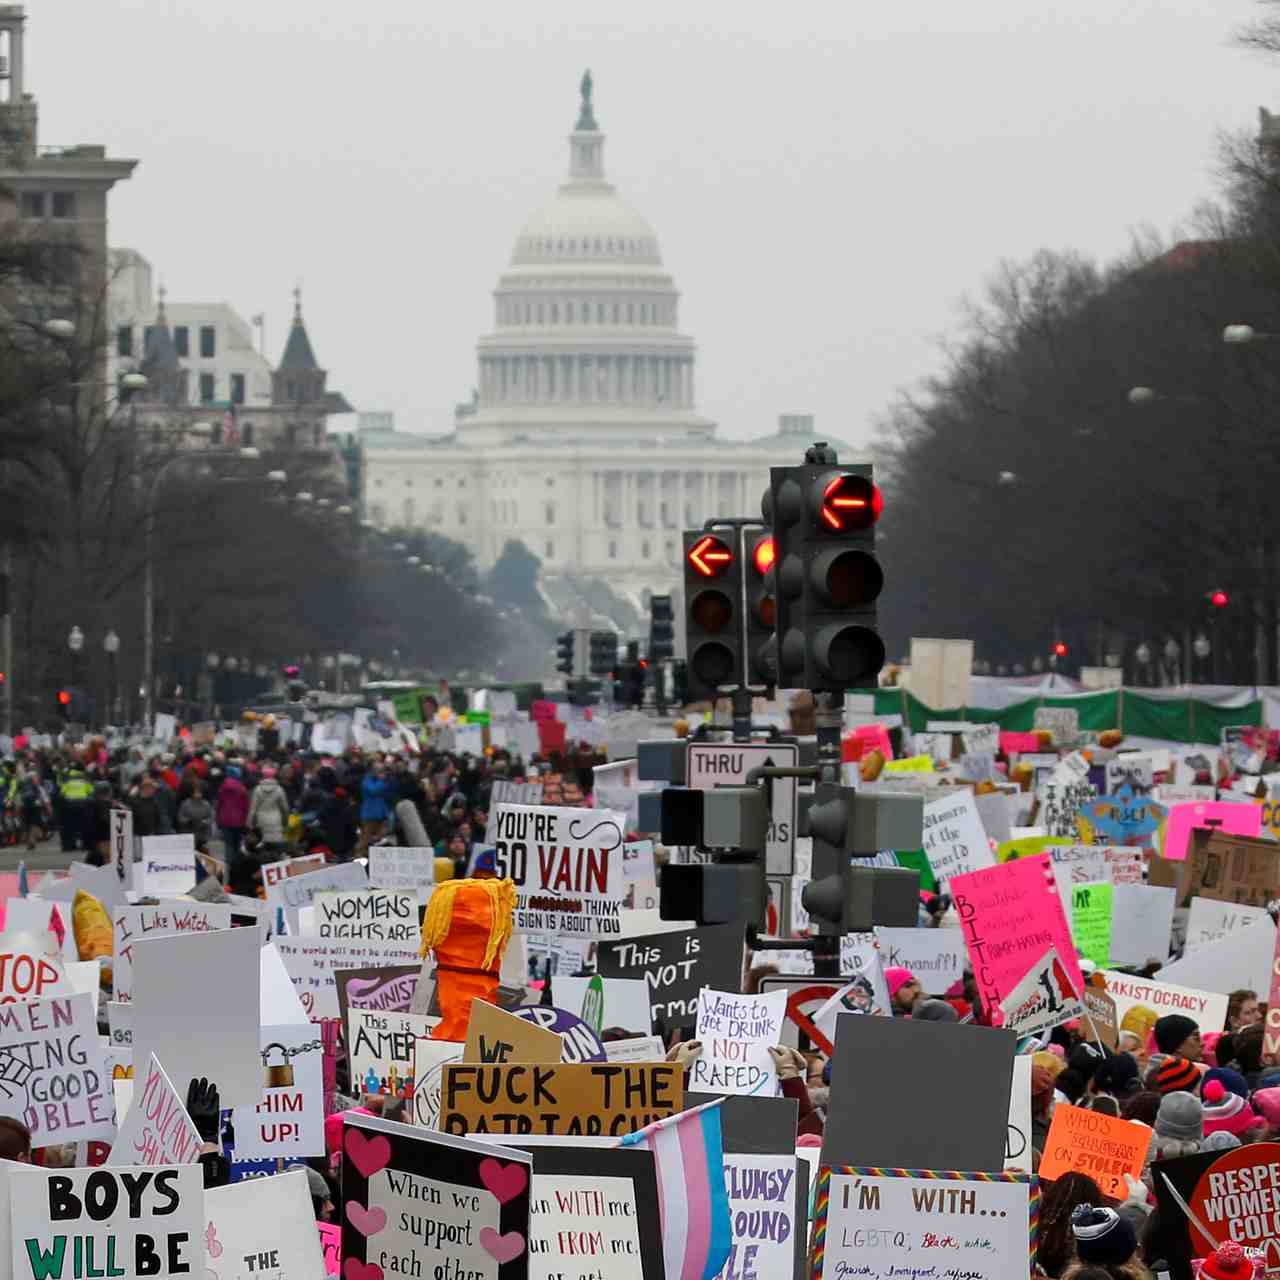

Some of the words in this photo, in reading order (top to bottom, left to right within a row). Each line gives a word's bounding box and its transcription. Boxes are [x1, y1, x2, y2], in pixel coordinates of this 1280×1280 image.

[696, 754, 743, 774] THRU
[496, 812, 557, 841] YOU'RE
[538, 848, 609, 896] VAIN
[322, 895, 411, 920] WOMENS
[585, 900, 620, 915] THINK
[141, 913, 168, 933] Like
[518, 912, 542, 928] SIGN
[546, 914, 556, 930] IS
[560, 915, 593, 932] ABOUT
[597, 917, 620, 934] YOU
[612, 943, 660, 967] This
[685, 937, 700, 954] is
[644, 960, 697, 989] NOT
[350, 976, 418, 1011] FEMINIST
[362, 1014, 388, 1030] This
[400, 1019, 410, 1031] is
[699, 1015, 720, 1034] get
[729, 1019, 776, 1038] DRUNK
[713, 1038, 756, 1062] NOT
[32, 1069, 99, 1102] GOOD
[448, 1066, 557, 1105] FUCK
[592, 1067, 674, 1109] THE
[256, 1093, 303, 1113] HIM
[261, 1123, 299, 1143] UP!
[1055, 1147, 1072, 1160] ON
[48, 1170, 180, 1222] BOYS
[384, 1169, 441, 1203] When
[452, 1191, 480, 1213] we
[555, 1190, 605, 1216] WITH
[843, 1179, 880, 1211] I'M
[398, 1209, 473, 1250] support
[25, 1234, 124, 1280] WILL
[134, 1232, 191, 1274] BE
[558, 1231, 604, 1255] FROM
[244, 1248, 280, 1273] THE
[380, 1252, 421, 1278] each
